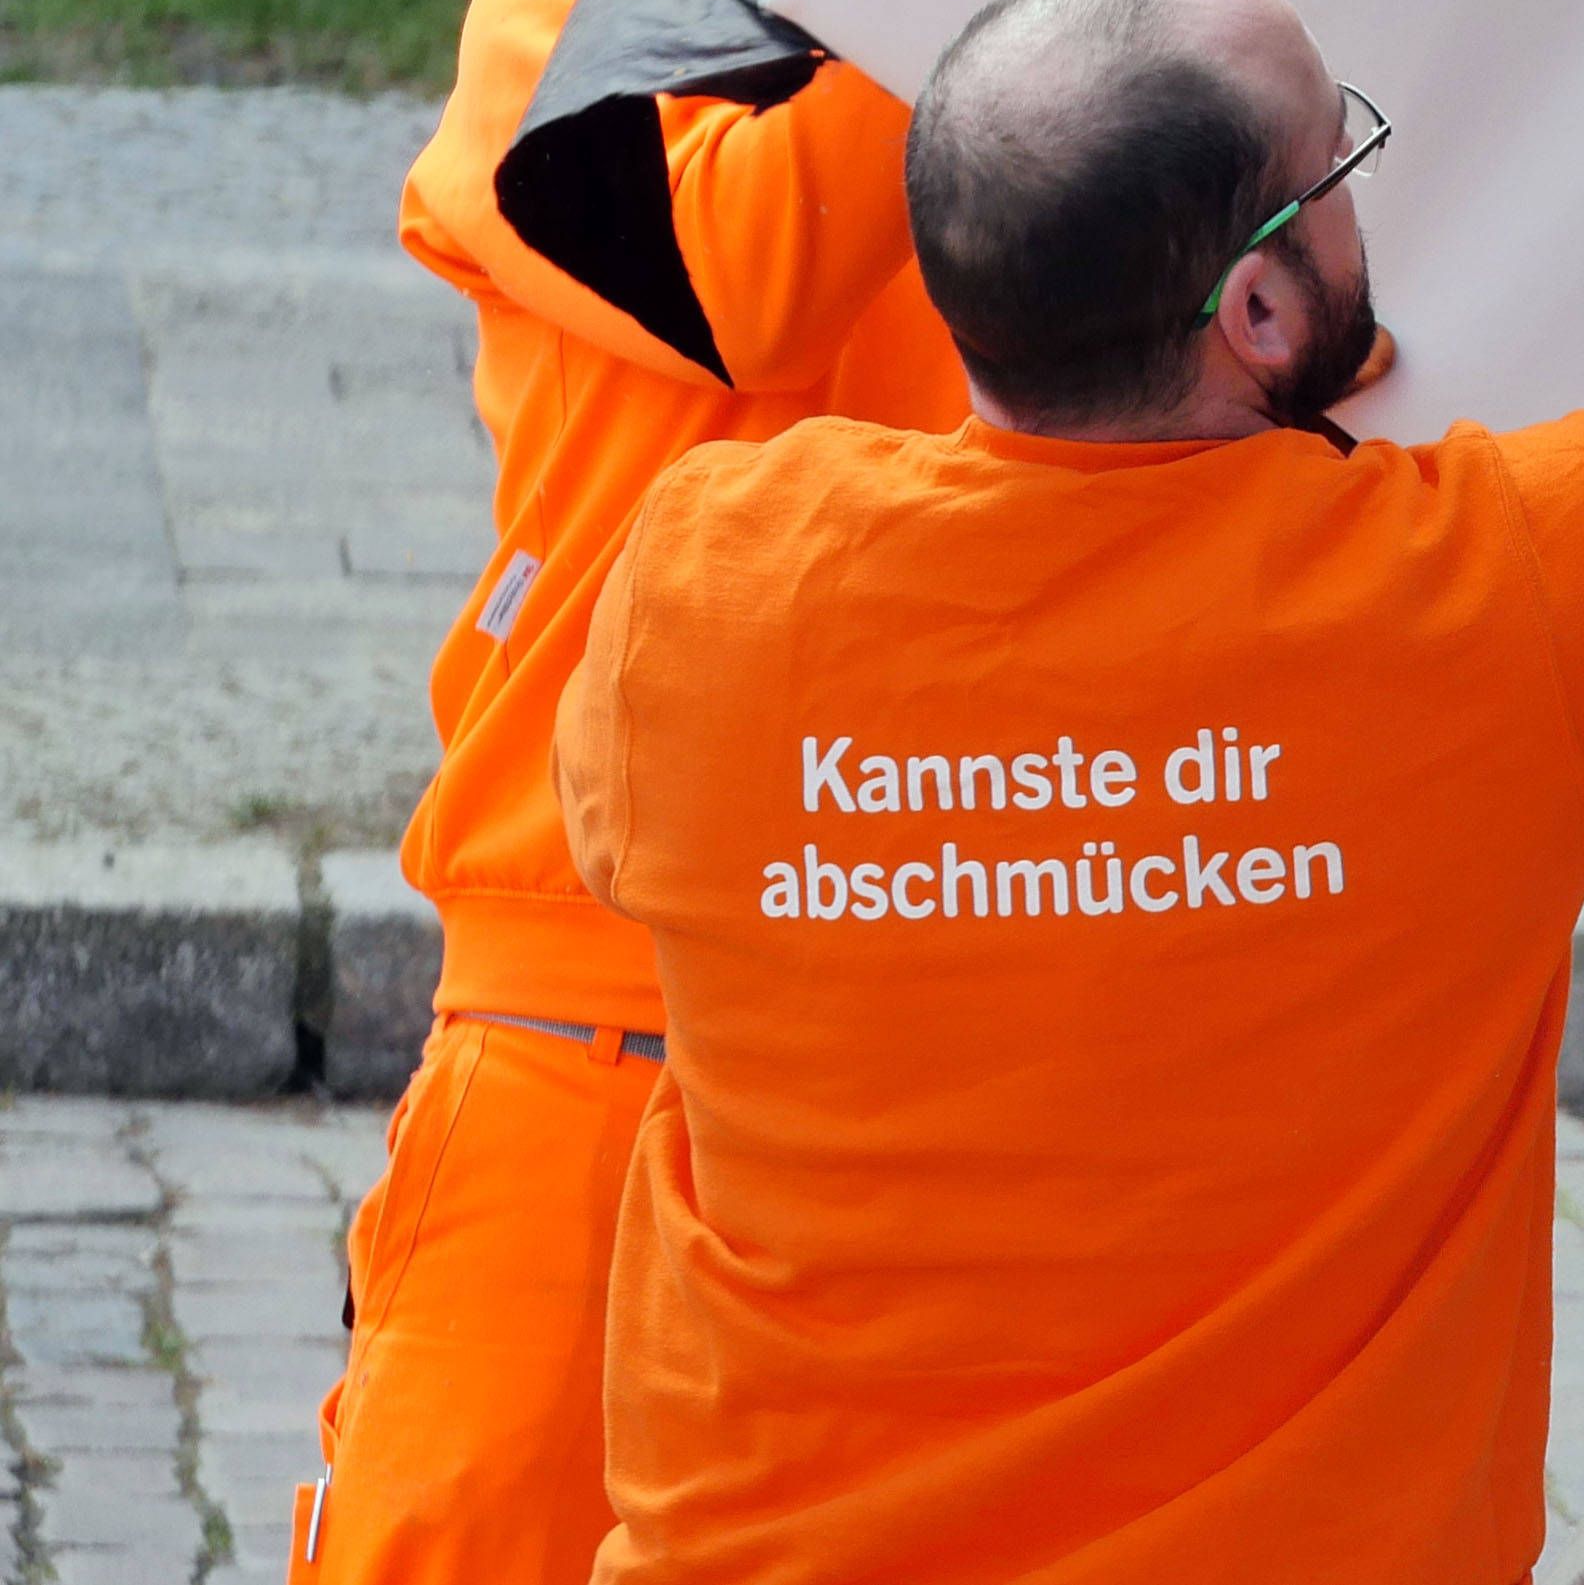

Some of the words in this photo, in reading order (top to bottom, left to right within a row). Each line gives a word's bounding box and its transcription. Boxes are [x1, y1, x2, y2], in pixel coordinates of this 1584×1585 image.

[802, 735, 1137, 814] Kannste
[1163, 726, 1281, 805] dir
[760, 834, 1344, 921] abschmücken
